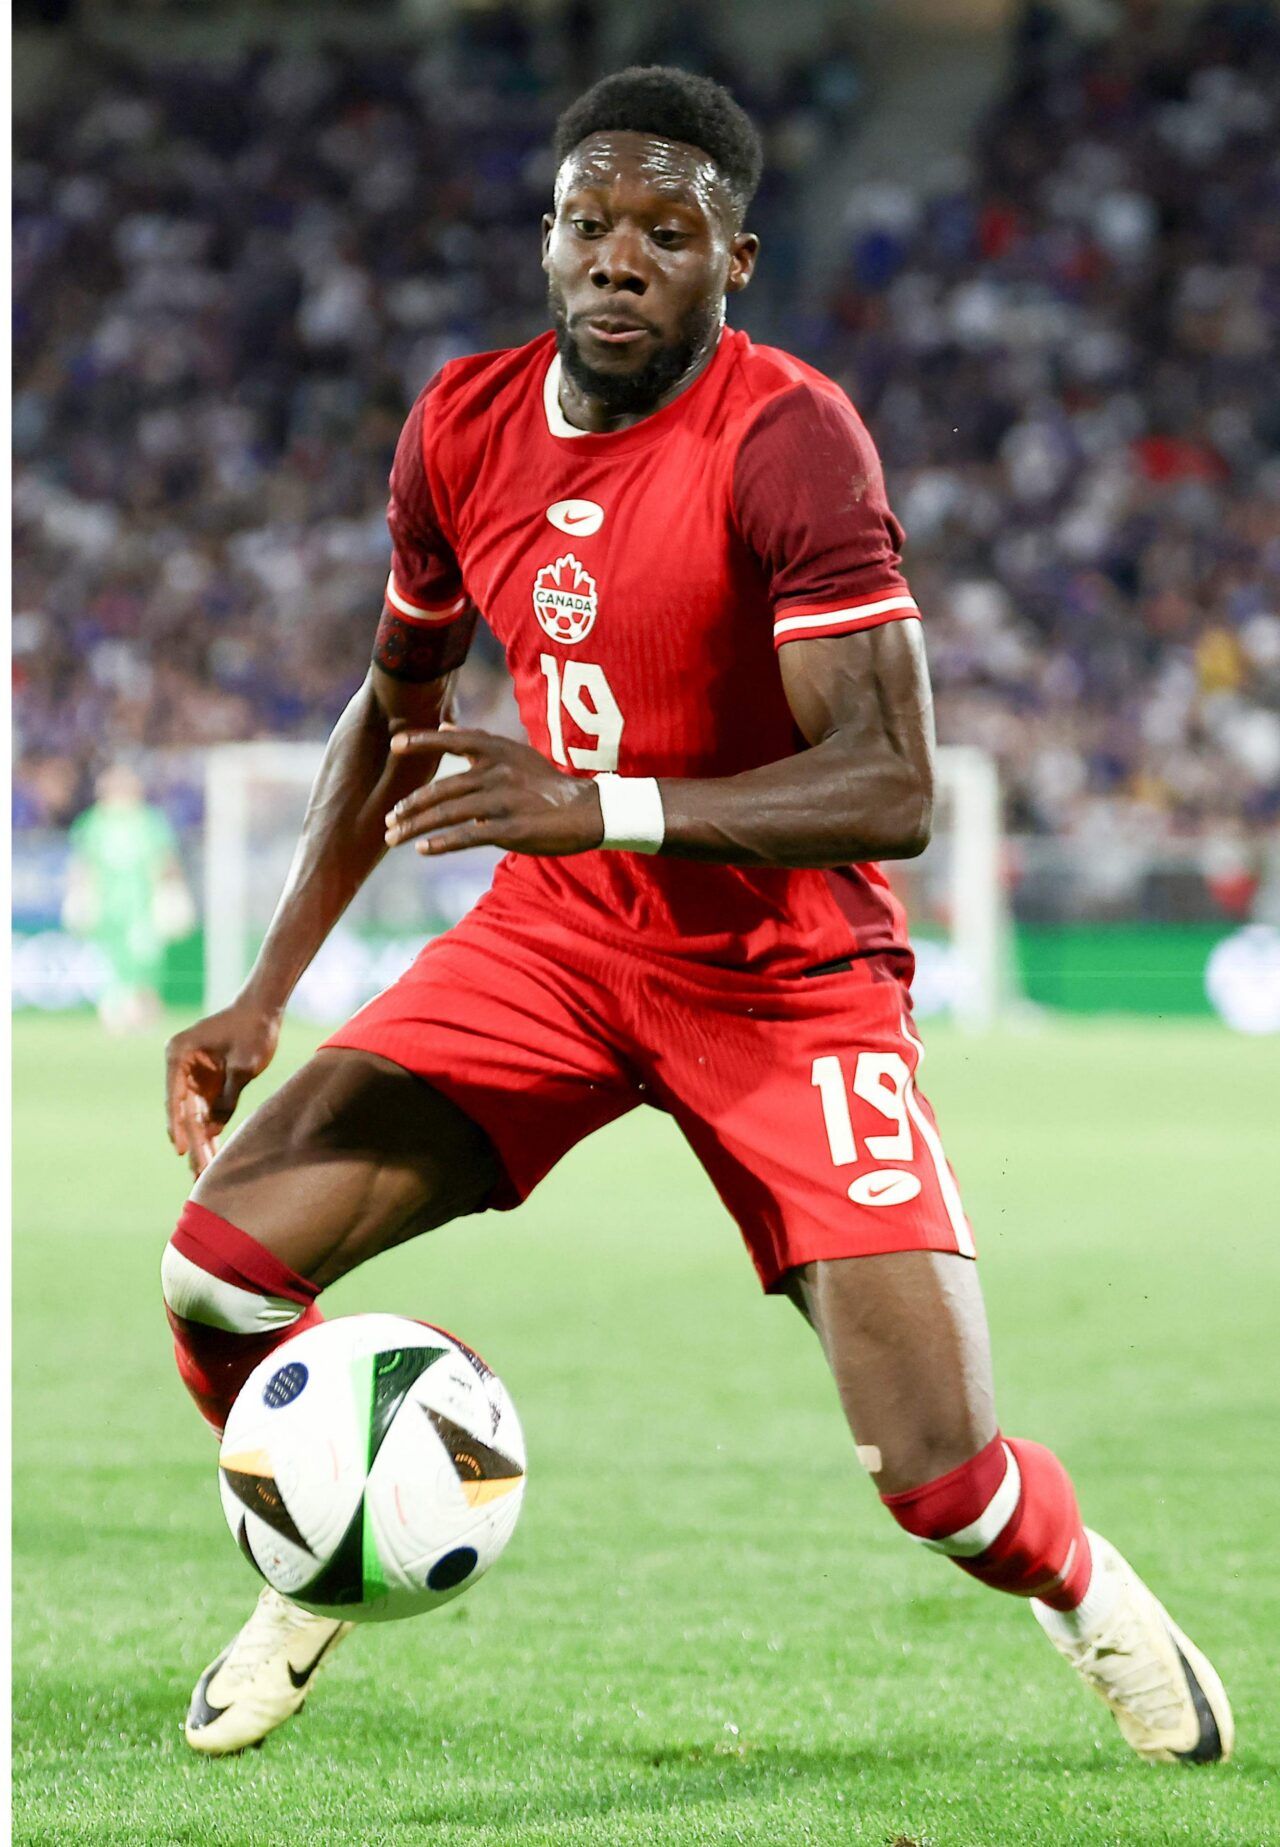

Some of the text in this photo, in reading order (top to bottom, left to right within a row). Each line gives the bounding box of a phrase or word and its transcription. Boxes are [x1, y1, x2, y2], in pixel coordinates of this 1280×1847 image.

[536, 591, 592, 611] CANADA
[540, 652, 625, 771] 19
[811, 1052, 914, 1167] 19
